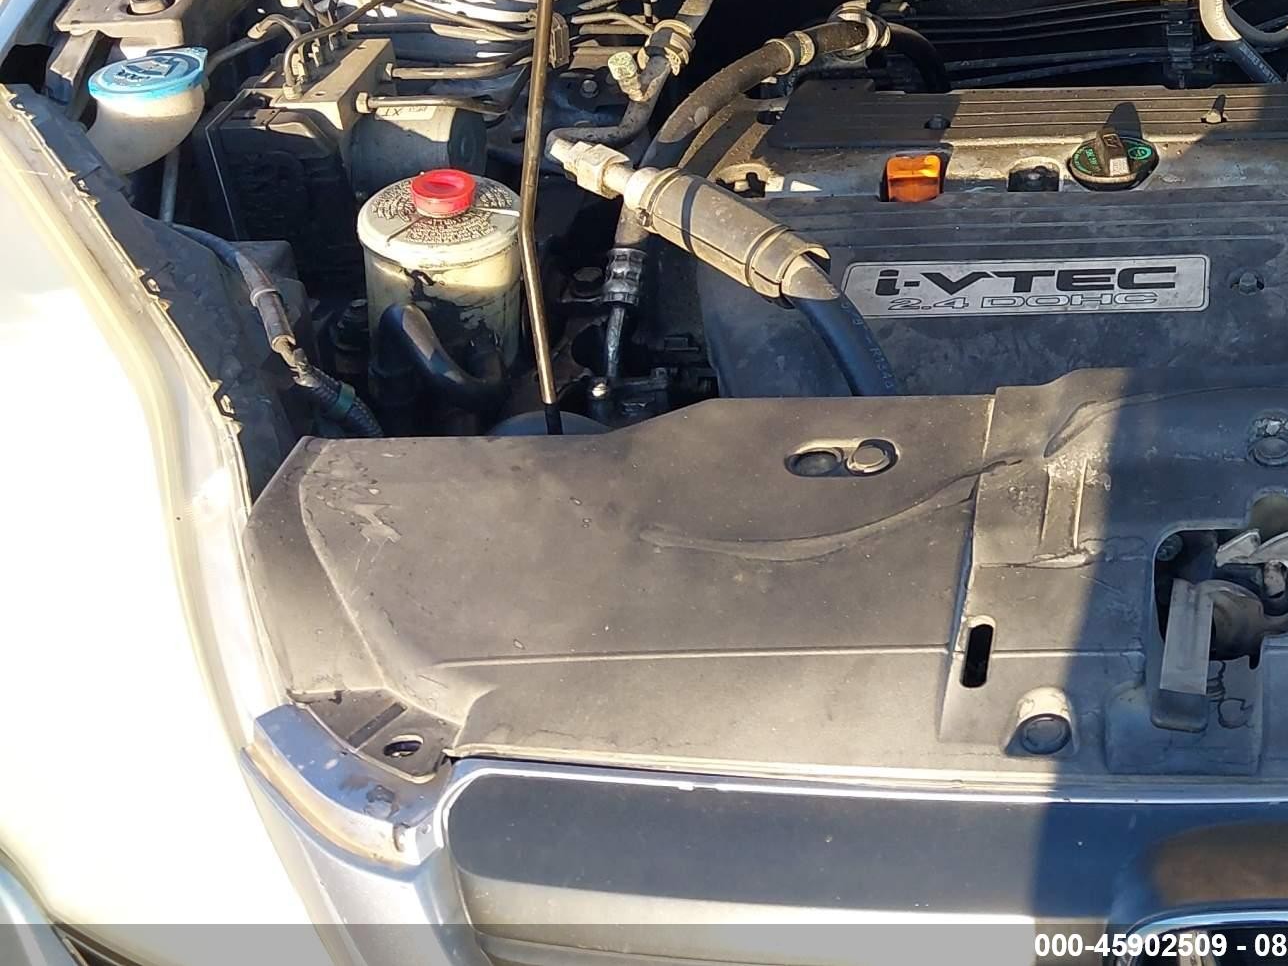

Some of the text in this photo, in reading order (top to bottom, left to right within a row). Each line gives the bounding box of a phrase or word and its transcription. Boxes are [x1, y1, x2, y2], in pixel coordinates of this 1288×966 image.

[875, 266, 1177, 296] i-VTEC
[887, 292, 1158, 311] 2.4 DOHC
